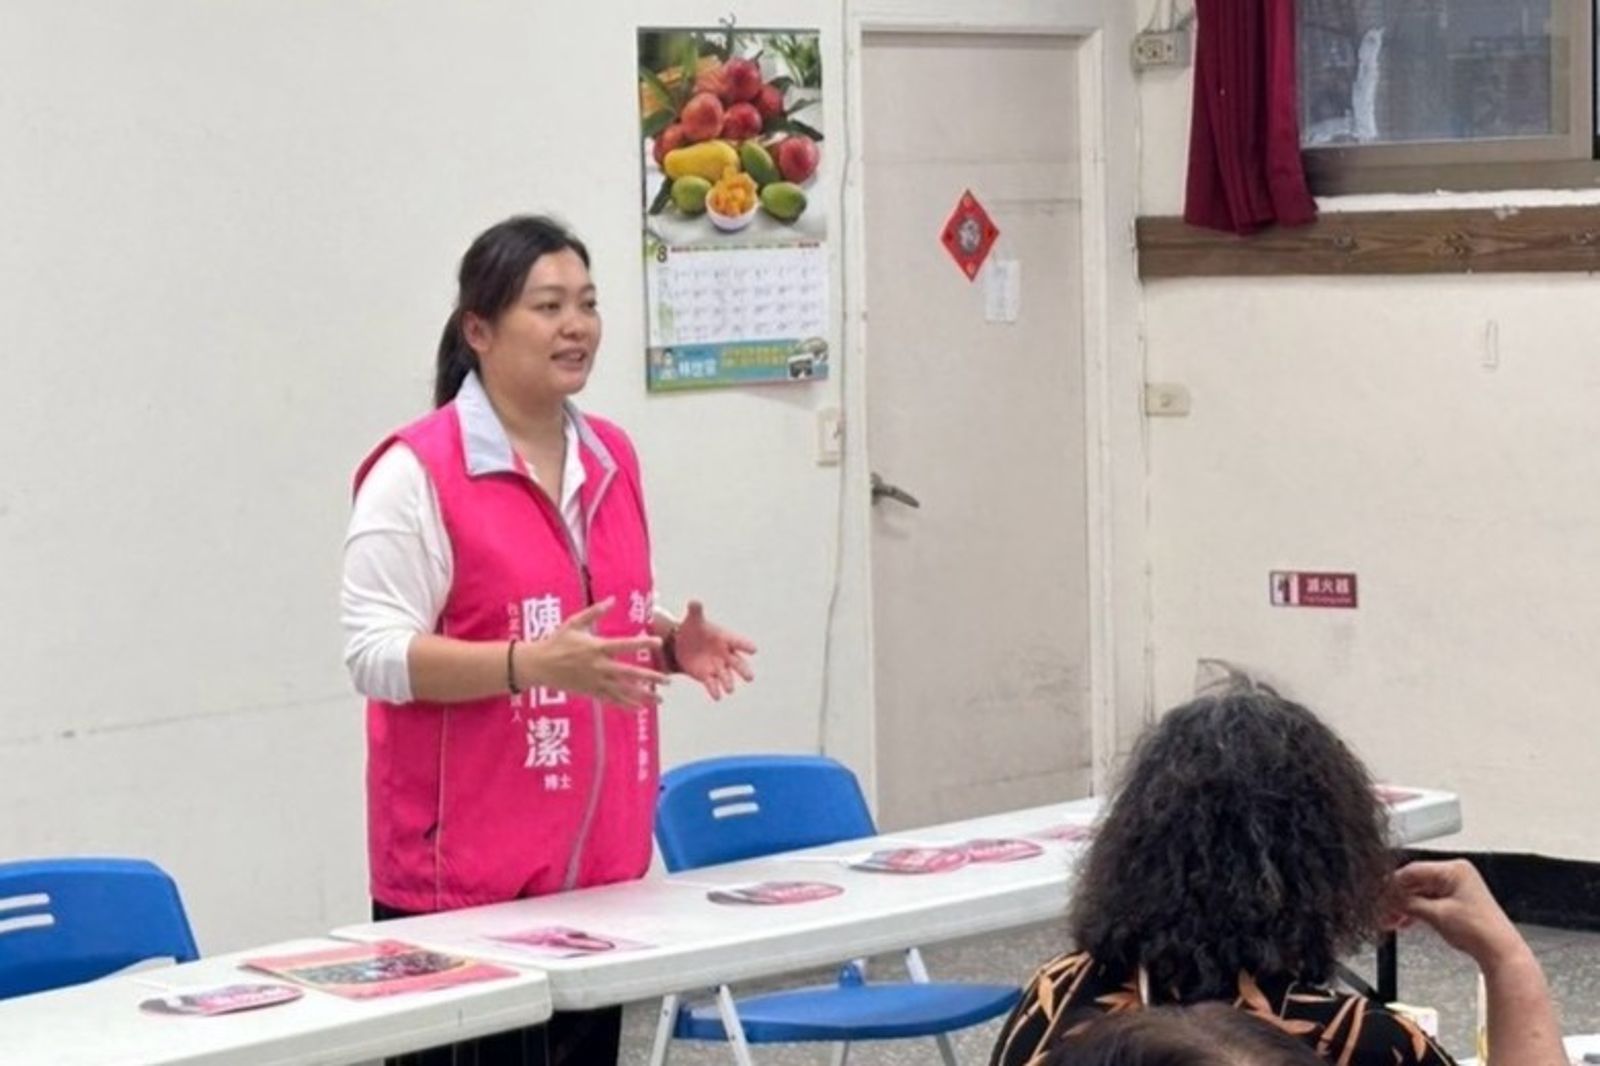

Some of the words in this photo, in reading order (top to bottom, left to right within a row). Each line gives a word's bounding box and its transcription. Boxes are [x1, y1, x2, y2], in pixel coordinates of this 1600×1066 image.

[656, 245, 668, 263] 8
[1306, 577, 1350, 595] 滅火器
[543, 773, 572, 791] 博士
